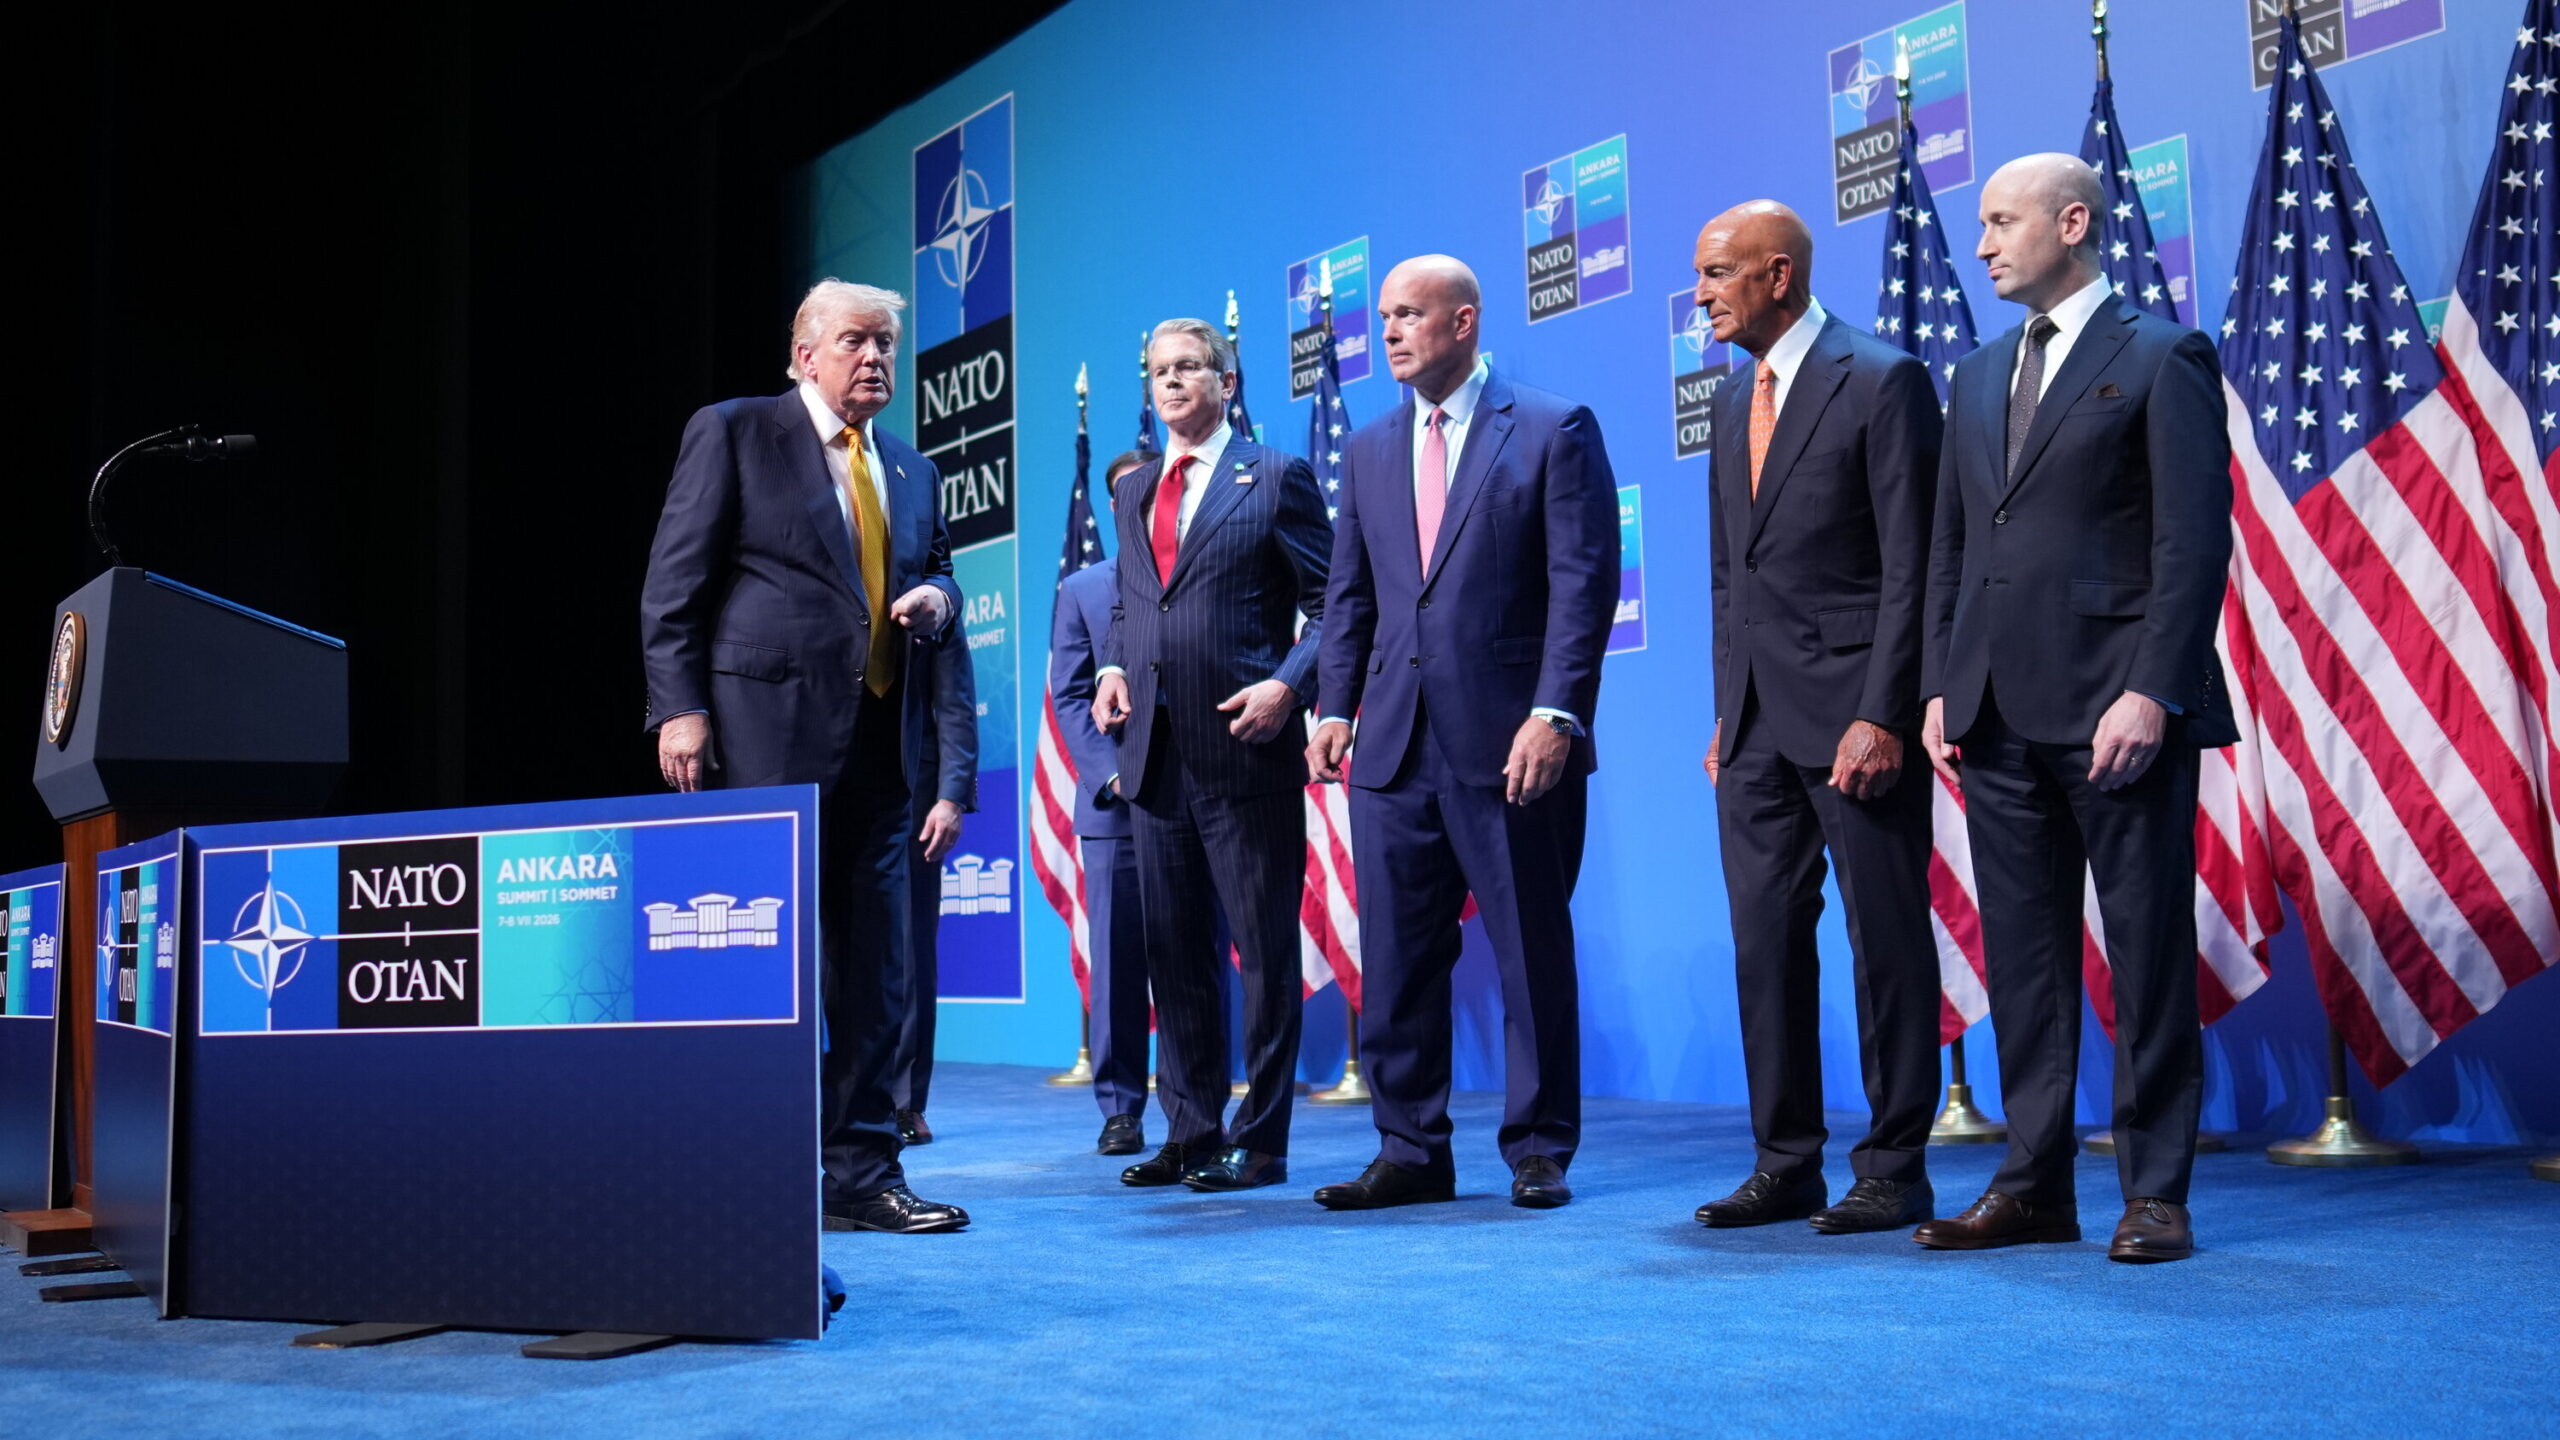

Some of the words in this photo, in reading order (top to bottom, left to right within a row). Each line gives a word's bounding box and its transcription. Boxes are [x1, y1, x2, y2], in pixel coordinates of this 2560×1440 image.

[1578, 153, 1621, 178] ANKARA
[1839, 131, 1894, 168] NATO
[2135, 159, 2178, 183] KARA
[1841, 174, 1896, 209] OTAN
[1530, 244, 1573, 274] NATO
[1531, 281, 1574, 311] OTAN
[1293, 331, 1327, 357] NATO
[922, 350, 1005, 425] NATO
[964, 591, 1006, 627] ARA
[497, 853, 619, 884] ANKARA
[349, 863, 467, 910] NATO
[497, 890, 549, 905] SUMMIT
[559, 885, 619, 902] SOMMET
[120, 888, 138, 924] NATO
[533, 913, 561, 926] 2026
[118, 967, 137, 1002] OTAN
[348, 958, 468, 1004] OTAN
